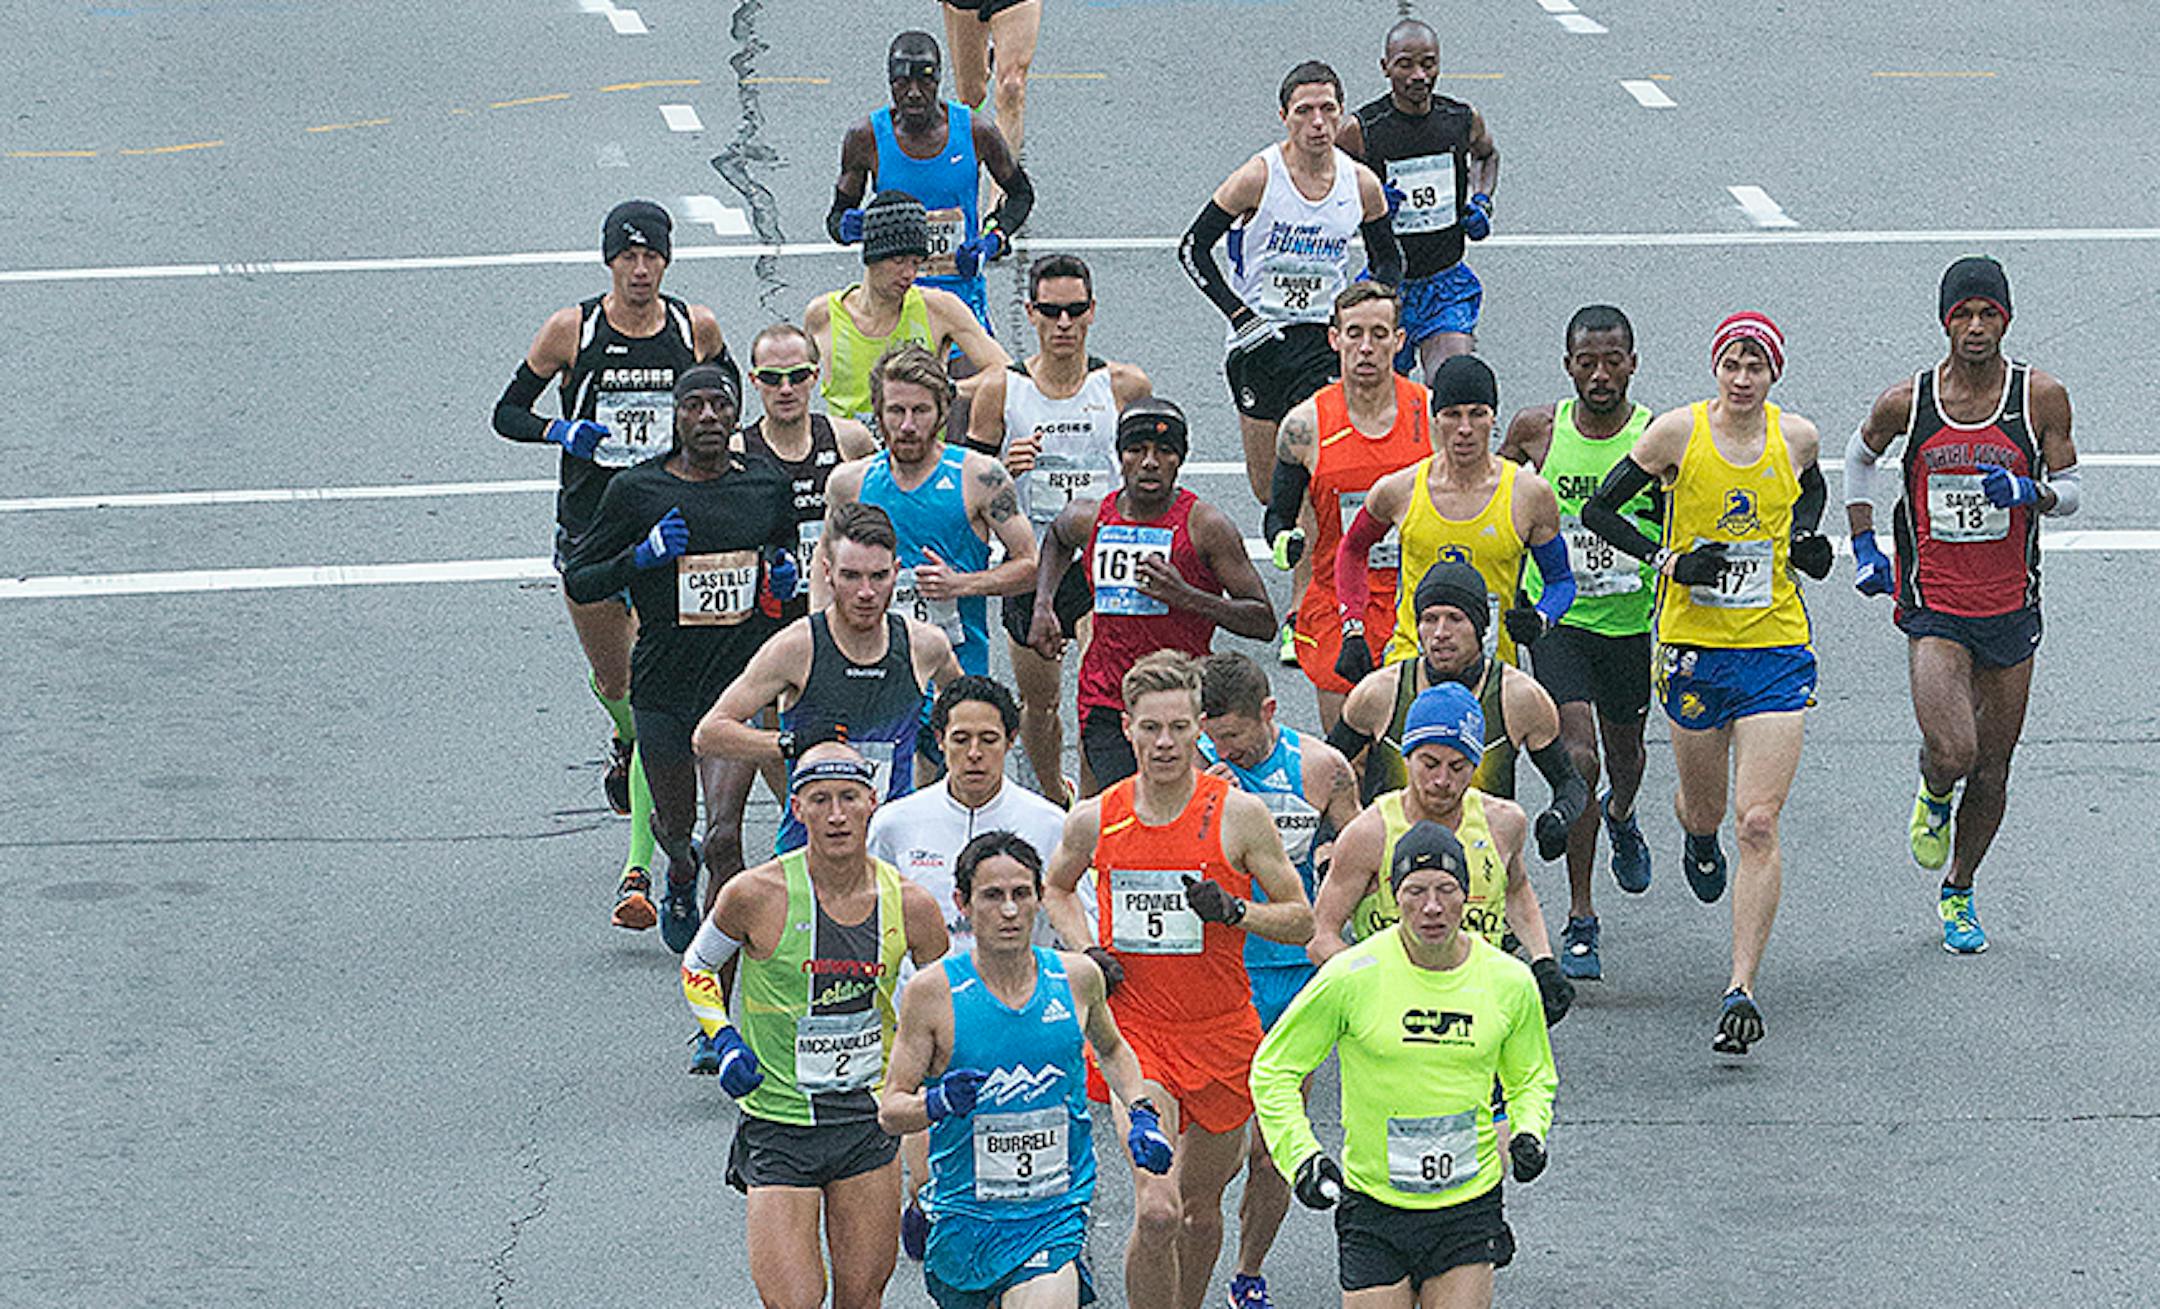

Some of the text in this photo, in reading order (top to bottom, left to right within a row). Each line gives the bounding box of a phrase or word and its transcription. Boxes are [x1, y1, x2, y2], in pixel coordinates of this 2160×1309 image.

[1412, 186, 1436, 209] 59
[1266, 236, 1347, 257] RUNNING
[1284, 288, 1310, 310] 28
[602, 368, 674, 382] AGGIES
[622, 422, 649, 445] 14
[1034, 422, 1093, 434] AGGIES
[1049, 473, 1091, 488] REYES
[1064, 488, 1073, 504] 1
[1955, 508, 1984, 529] 13
[1097, 549, 1166, 580] 161
[1586, 548, 1614, 571] 58
[689, 568, 751, 589] CASTILLE
[1719, 573, 1745, 595] 17
[700, 589, 739, 612] 201
[914, 600, 928, 622] 6
[1148, 912, 1164, 938] 5
[835, 1053, 852, 1078] 2
[987, 1130, 1058, 1154] BURRELL
[1017, 1153, 1033, 1178] 3
[1422, 1153, 1453, 1181] 60
